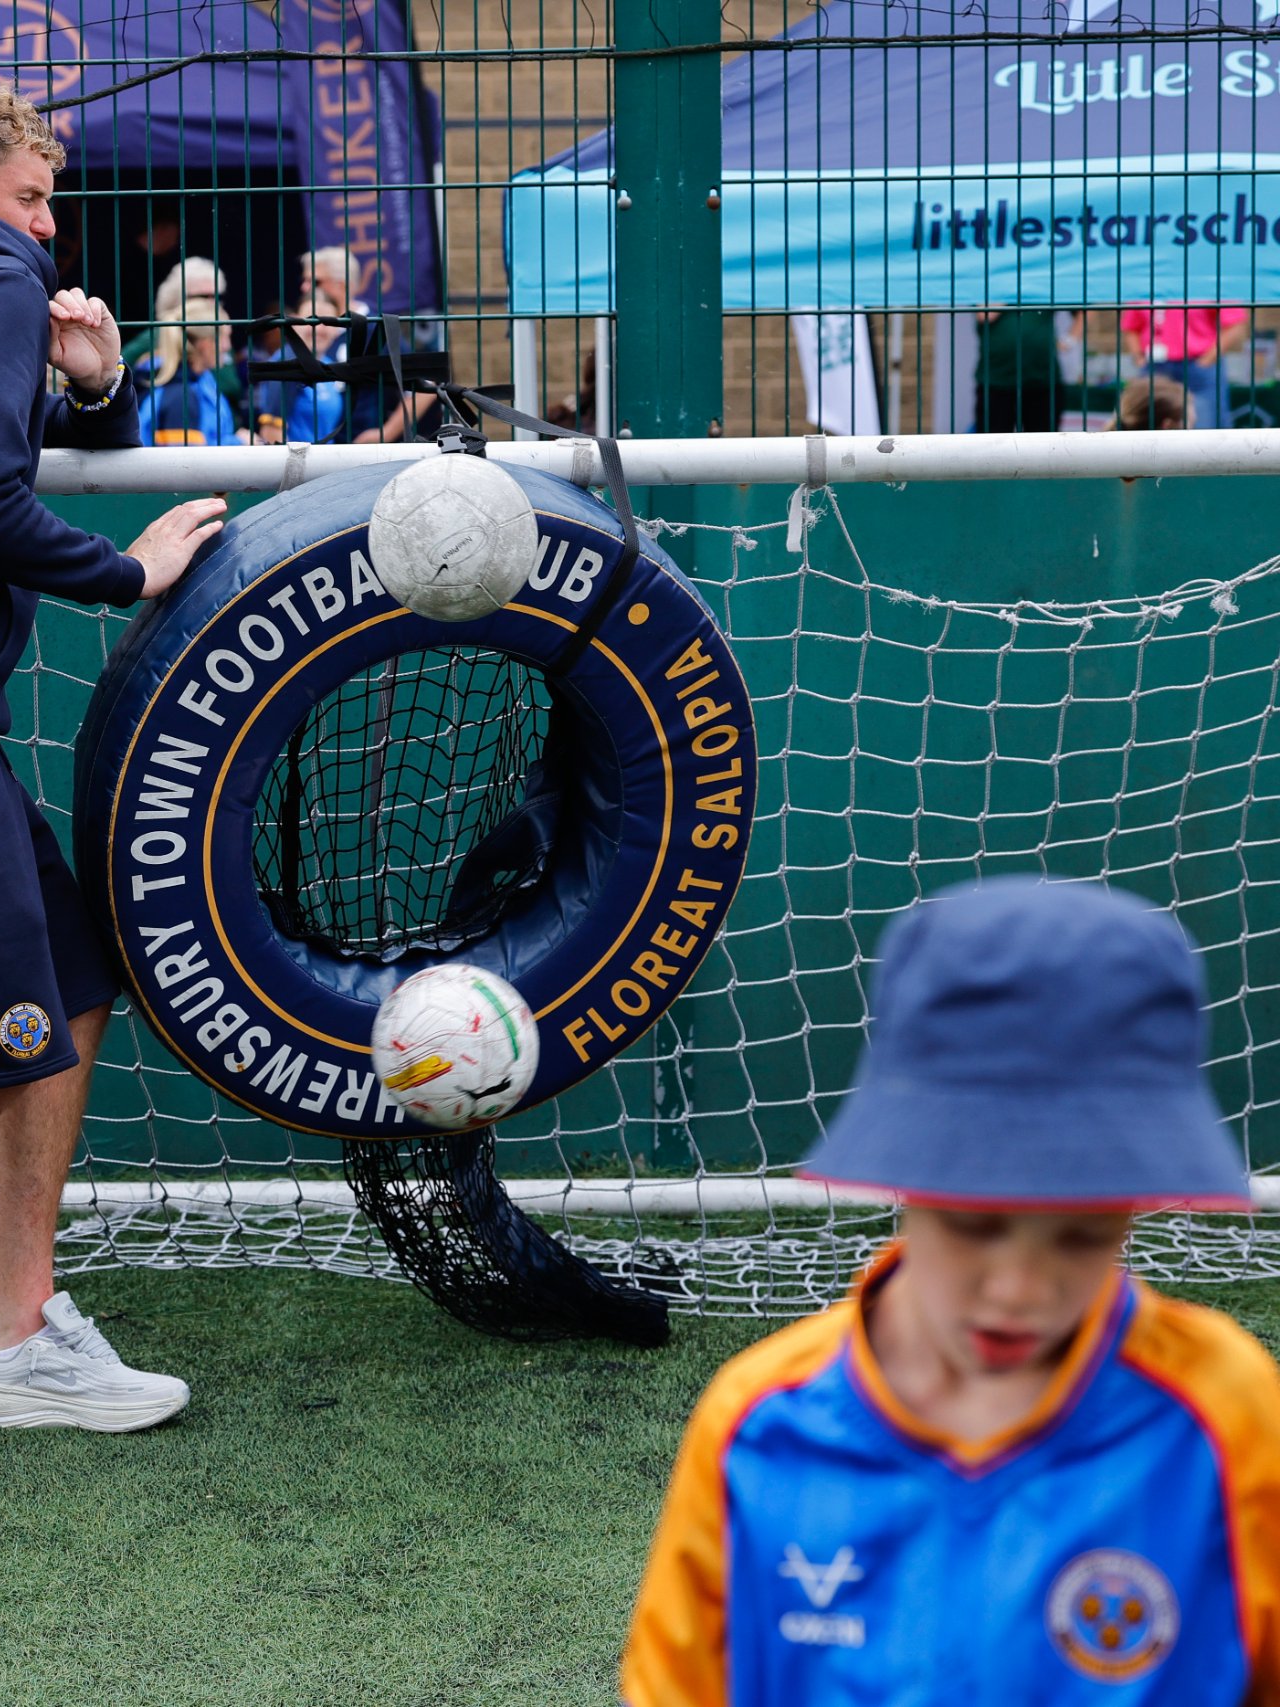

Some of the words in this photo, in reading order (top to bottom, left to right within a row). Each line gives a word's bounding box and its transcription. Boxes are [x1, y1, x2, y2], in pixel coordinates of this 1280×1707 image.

[314, 36, 394, 295] SHUKER
[994, 54, 1192, 115] Little
[1221, 50, 1280, 98] S
[178, 550, 386, 727] FOOTBA
[528, 535, 604, 603] UB
[131, 732, 210, 901] TOWN
[562, 868, 724, 1063] FLOREAT
[663, 637, 743, 851] SALOPIA
[139, 919, 405, 1124] HREWSBURY
